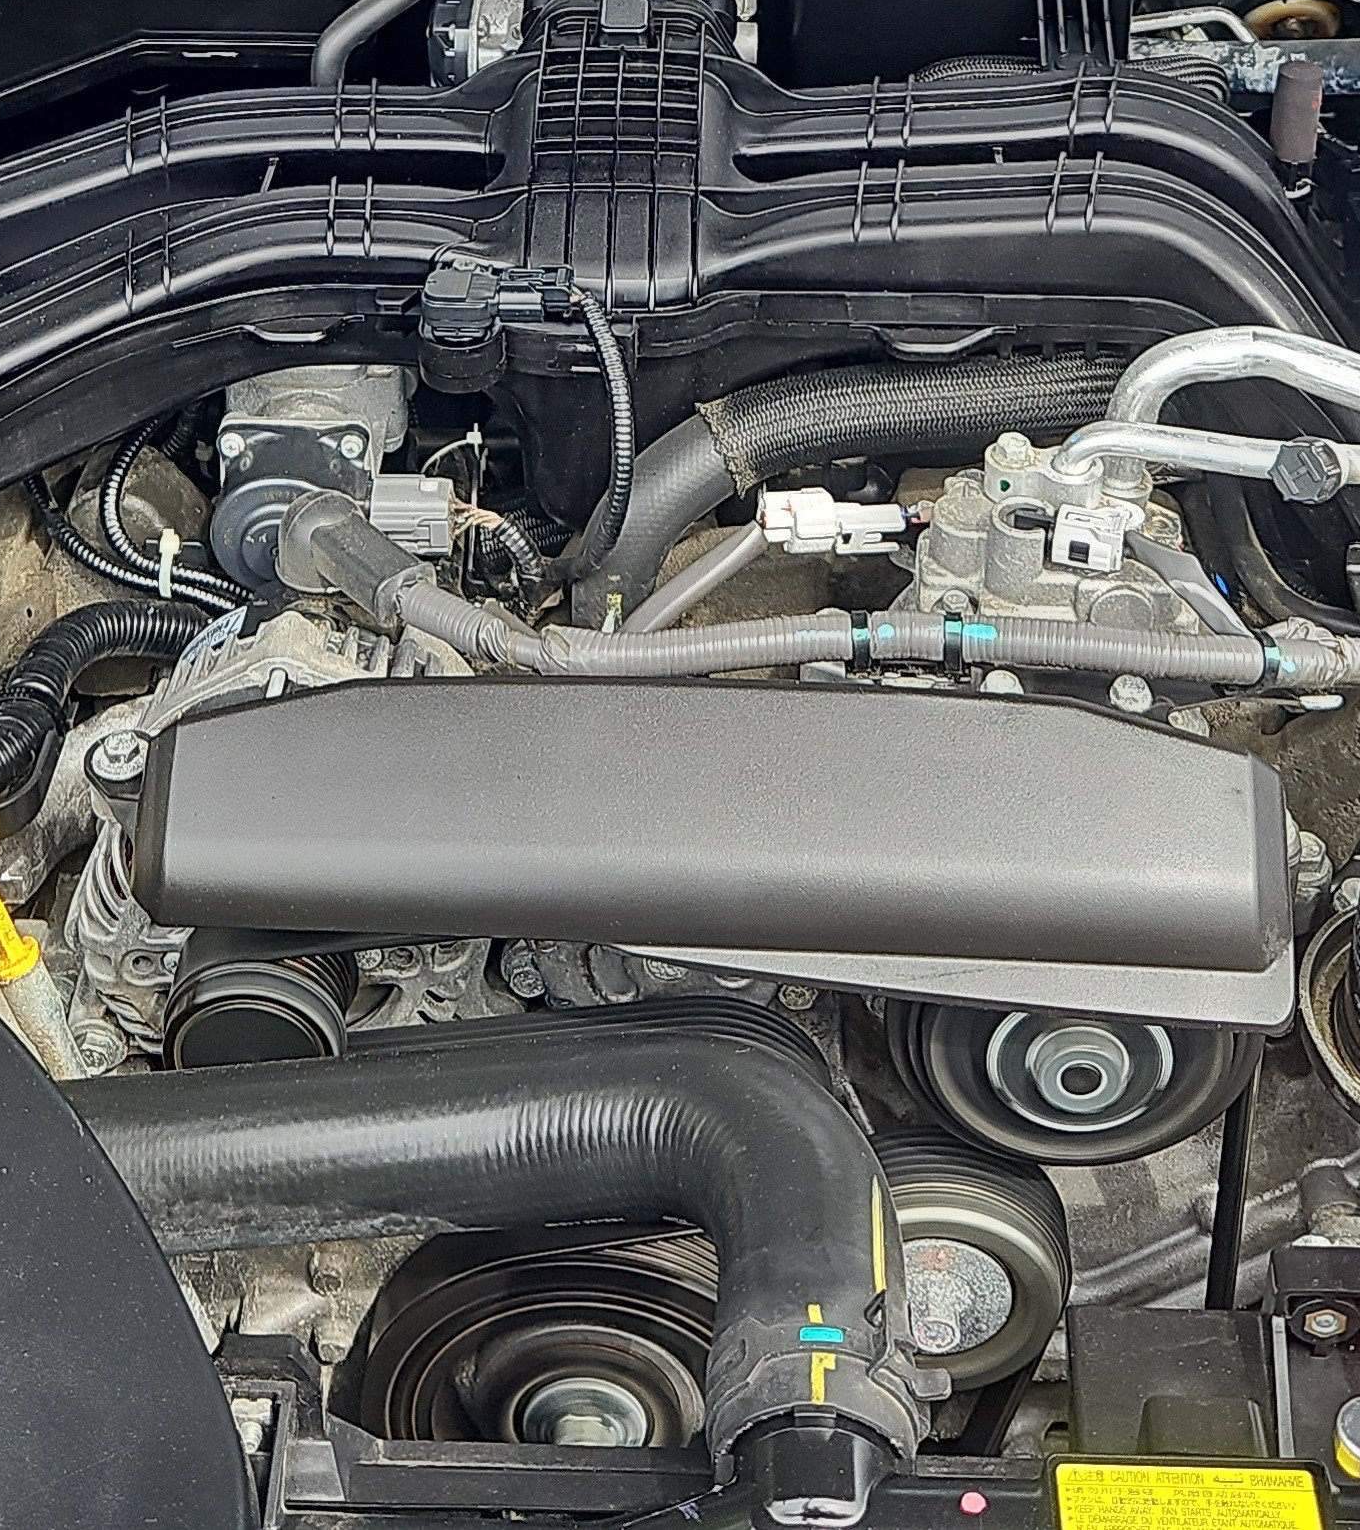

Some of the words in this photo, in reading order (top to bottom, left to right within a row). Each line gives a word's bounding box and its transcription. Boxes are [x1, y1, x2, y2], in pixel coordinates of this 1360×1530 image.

[1111, 1471, 1150, 1483] CAUTION
[1156, 1472, 1204, 1484] ATTENTION
[1074, 1505, 1094, 1513] KEEP
[1162, 1507, 1177, 1515] FAN
[1181, 1508, 1211, 1516] STARTS
